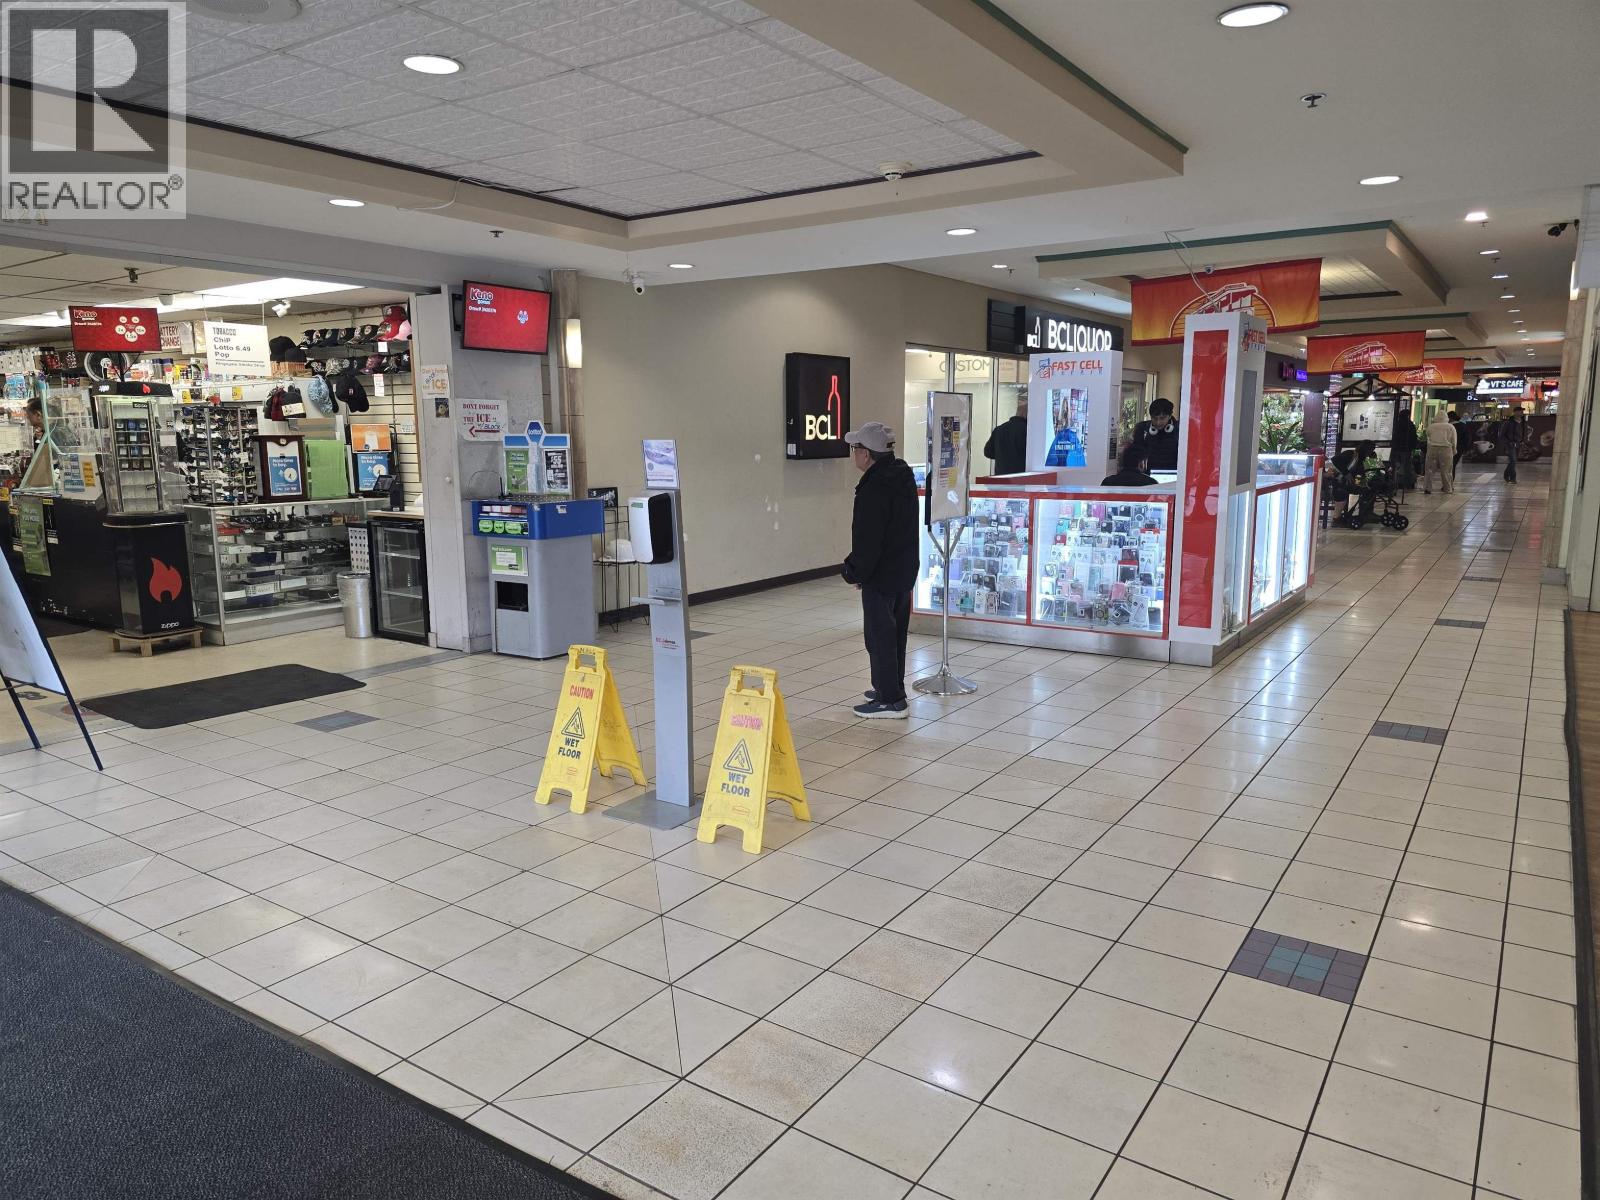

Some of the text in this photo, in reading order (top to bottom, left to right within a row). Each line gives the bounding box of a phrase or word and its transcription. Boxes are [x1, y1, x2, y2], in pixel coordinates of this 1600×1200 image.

[469, 287, 493, 301] Keno
[160, 326, 179, 336] ATTERY
[213, 327, 237, 336] TOBACCO
[1051, 360, 1103, 371] FAST CELL
[432, 379, 447, 391] ICE
[476, 413, 491, 423] ICE
[569, 684, 595, 700] CAUTION
[564, 737, 580, 748] WET
[557, 747, 581, 760] FLOOR
[728, 771, 747, 784] WET
[720, 783, 750, 798] FLOOR
